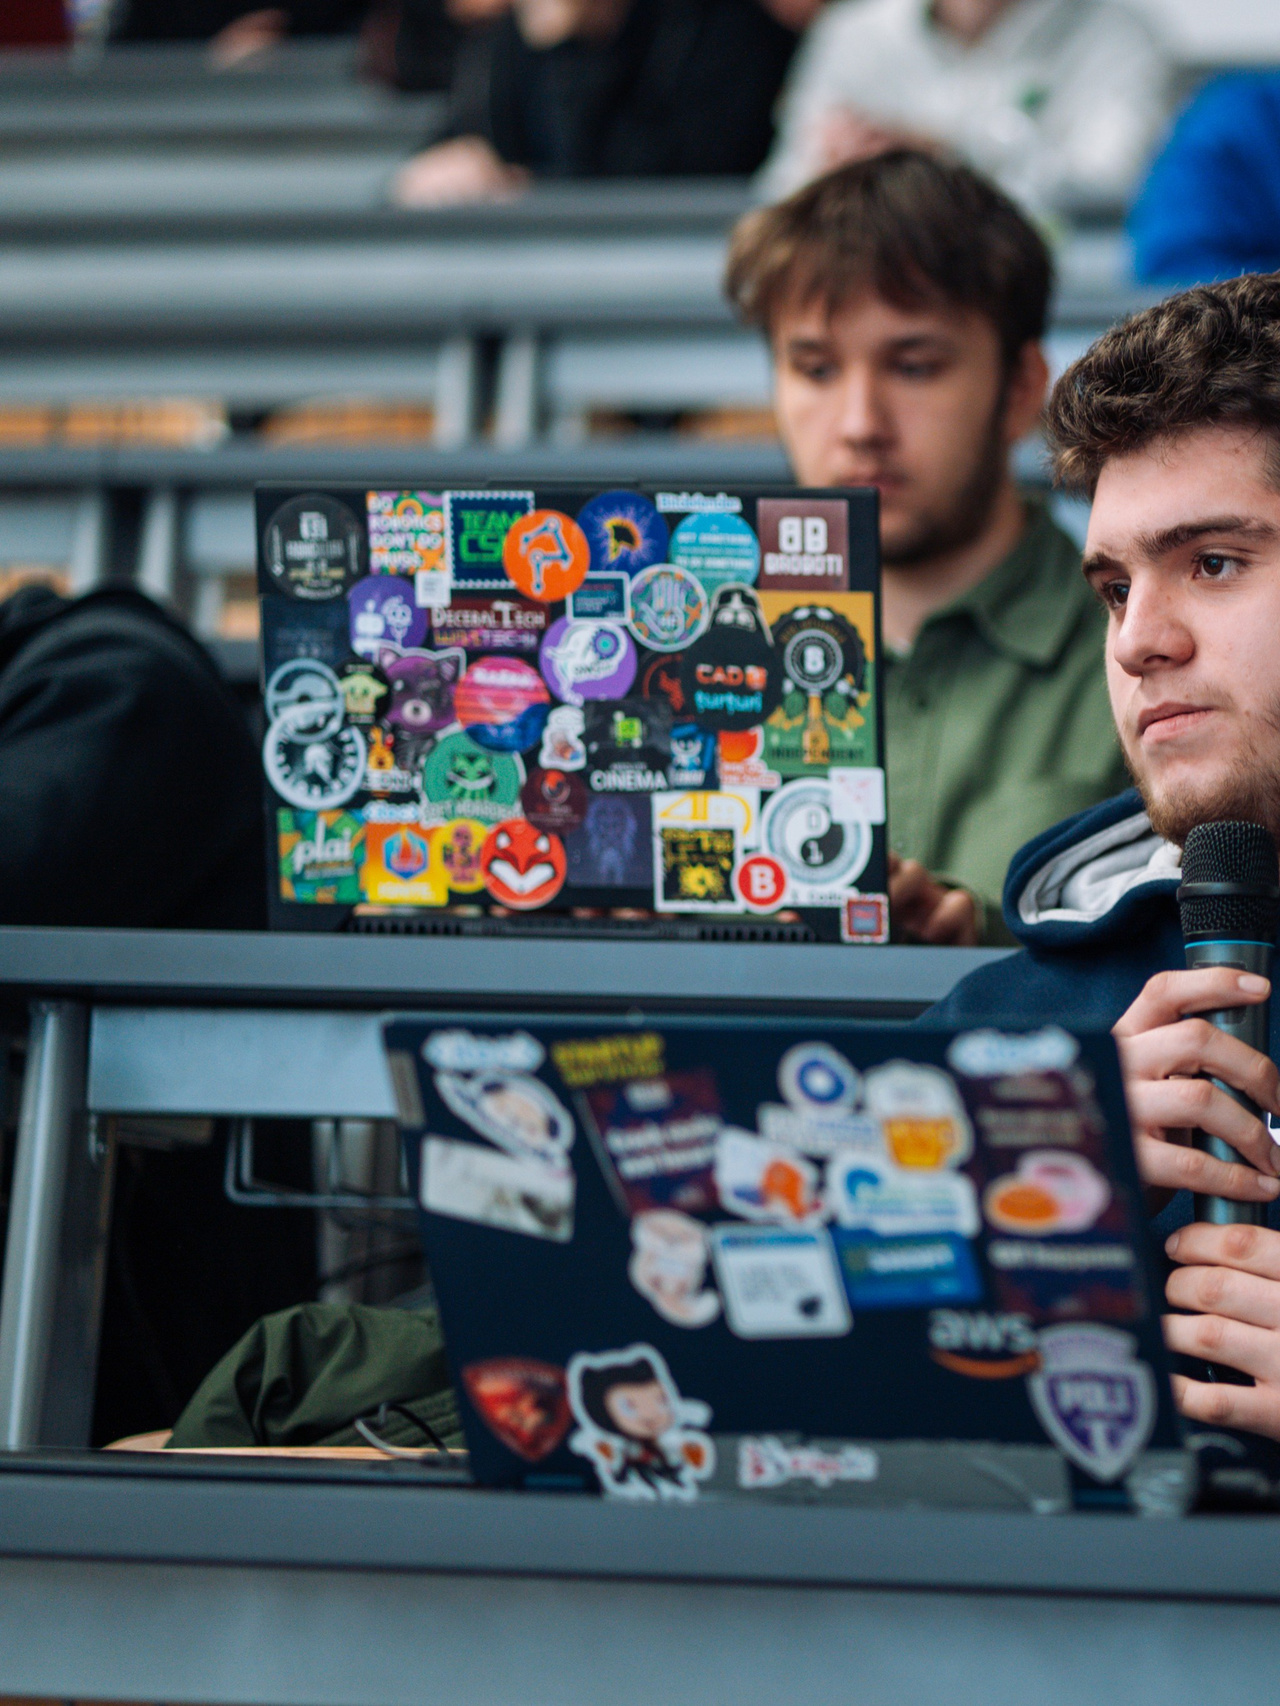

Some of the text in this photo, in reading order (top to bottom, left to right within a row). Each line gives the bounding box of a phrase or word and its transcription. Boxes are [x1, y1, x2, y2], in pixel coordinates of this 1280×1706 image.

[370, 515, 443, 532] ROBOTICS
[459, 531, 505, 563] CS
[590, 769, 668, 792] CINEMA
[750, 863, 776, 899] B
[931, 1309, 1036, 1352] aws
